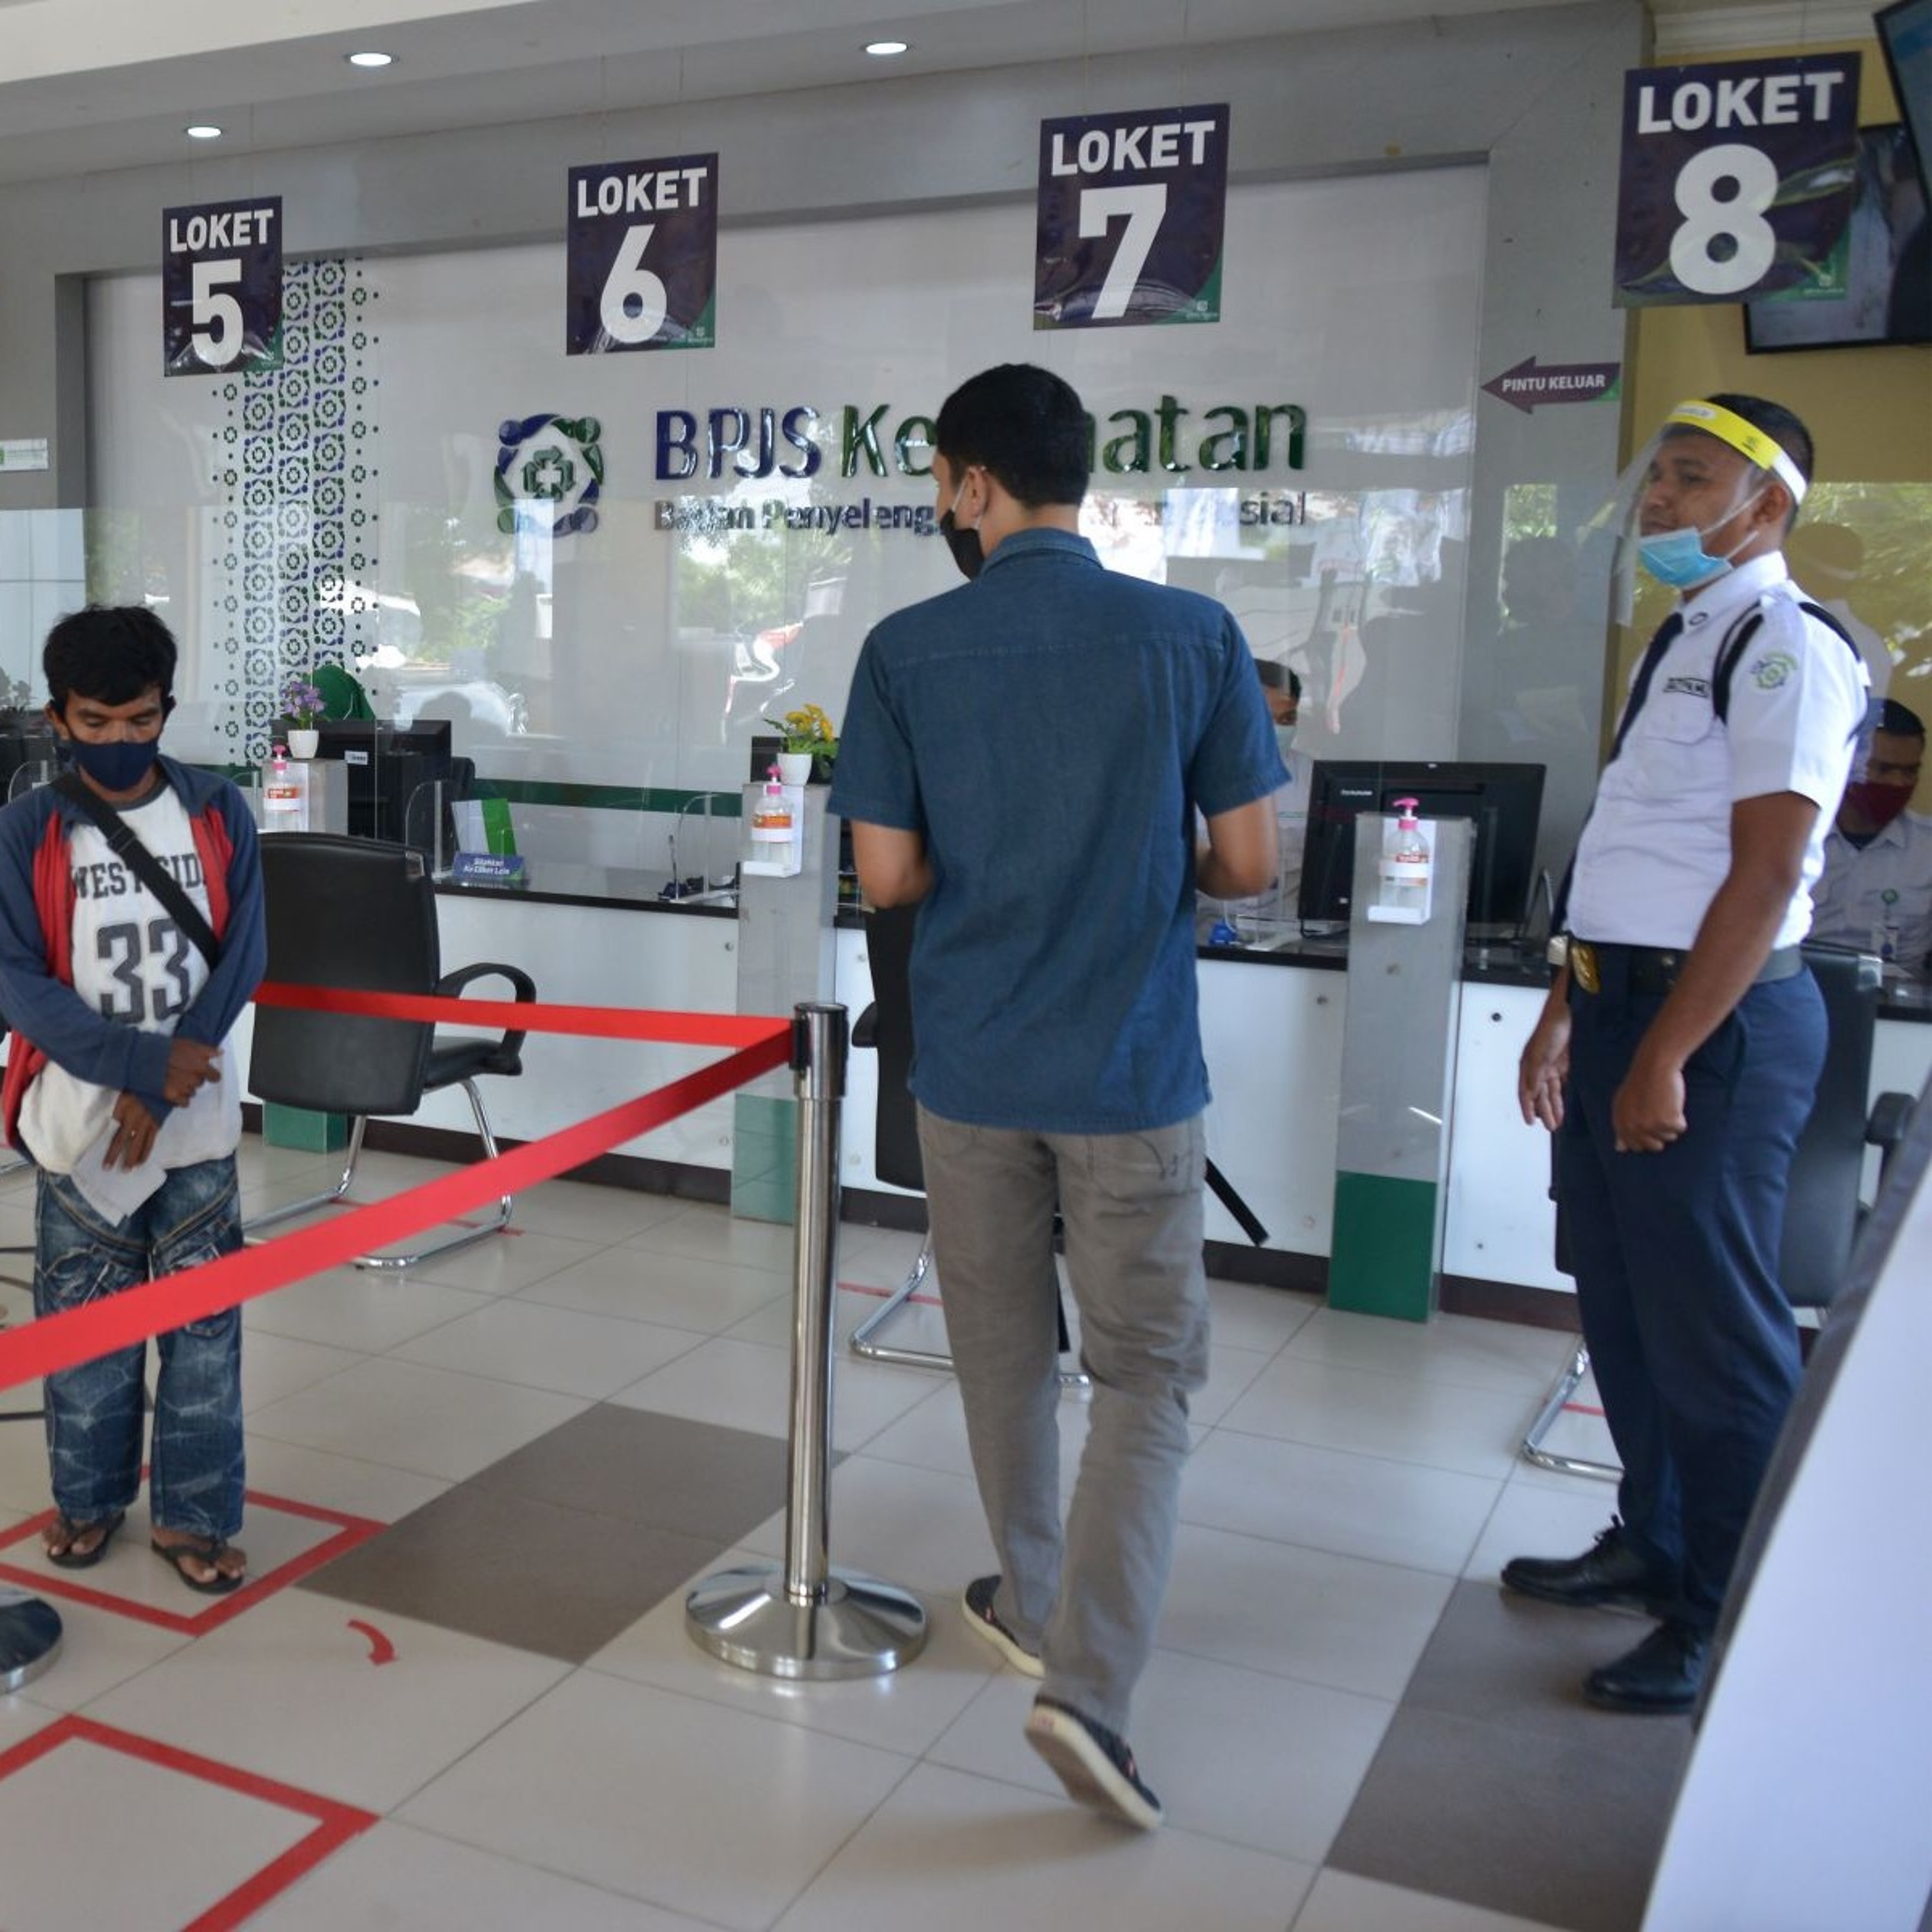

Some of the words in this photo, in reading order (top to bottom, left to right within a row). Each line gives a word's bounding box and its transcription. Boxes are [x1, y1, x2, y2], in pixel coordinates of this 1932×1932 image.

[1637, 71, 1844, 134] LOKET
[1051, 120, 1216, 176] LOKET
[577, 167, 708, 218] LOKET
[1669, 144, 1778, 294] 8
[169, 209, 274, 253] LOKET
[1079, 183, 1168, 319] 7
[191, 258, 244, 366] 5
[600, 223, 667, 343] 6
[1502, 377, 1546, 392] PINTU
[1548, 374, 1605, 390] KELUAR
[655, 406, 822, 480] BPJS
[96, 918, 190, 1023] 33
